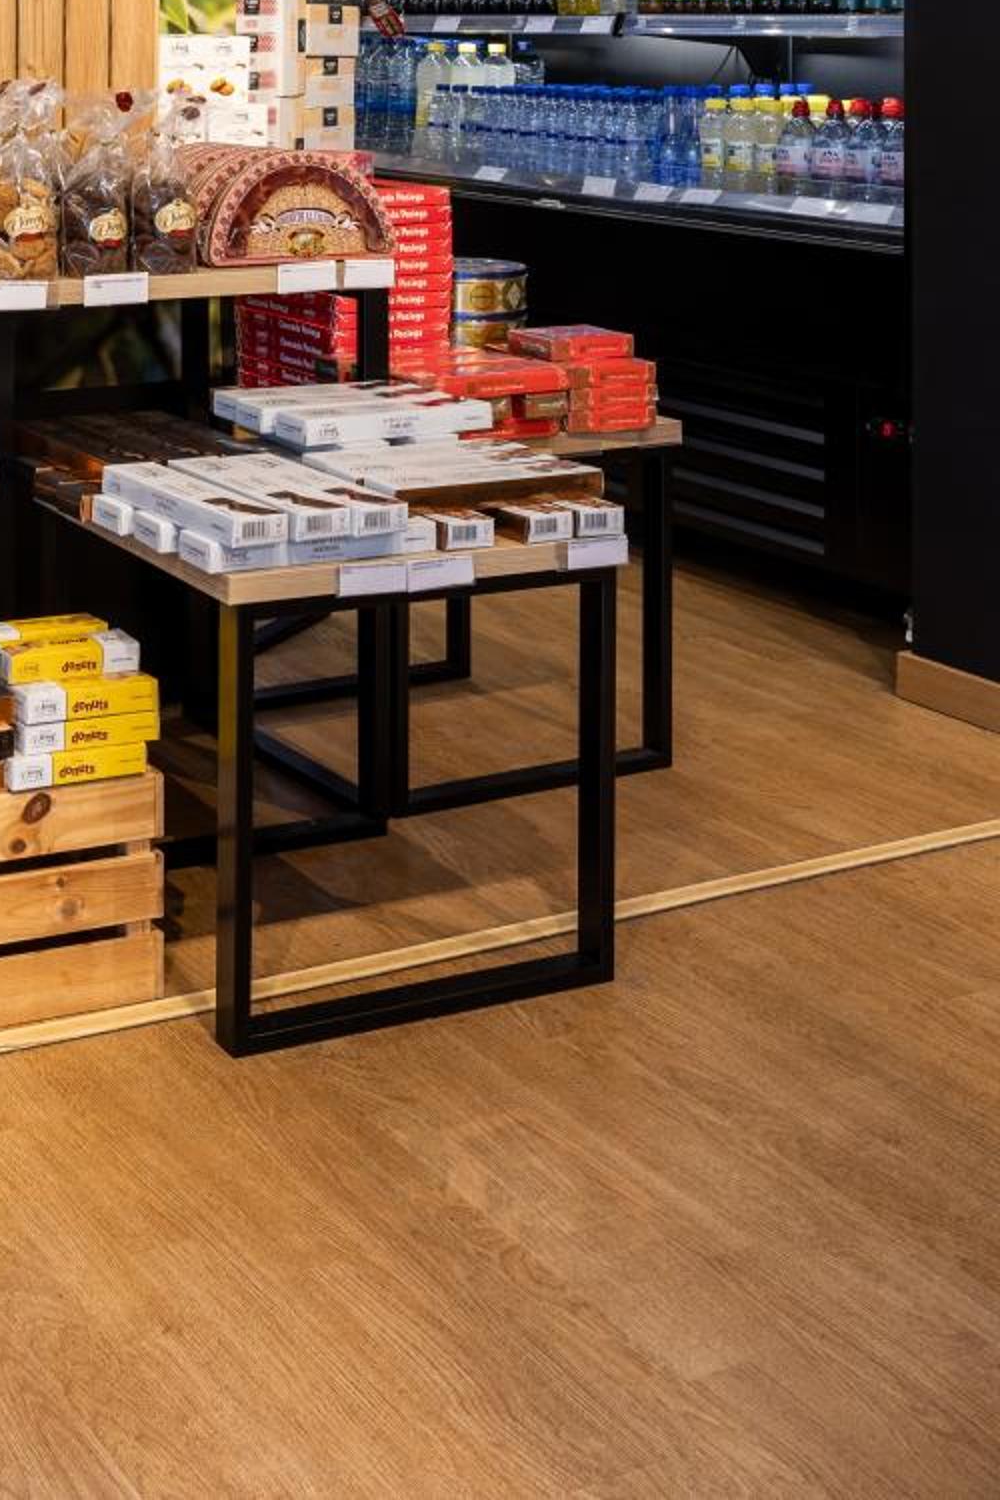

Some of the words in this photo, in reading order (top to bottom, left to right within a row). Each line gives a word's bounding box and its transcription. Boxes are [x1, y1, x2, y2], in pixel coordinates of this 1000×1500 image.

[61, 660, 97, 673] donuts
[72, 700, 109, 714] donuts
[71, 731, 109, 744] donuts
[59, 763, 95, 777] donuts
